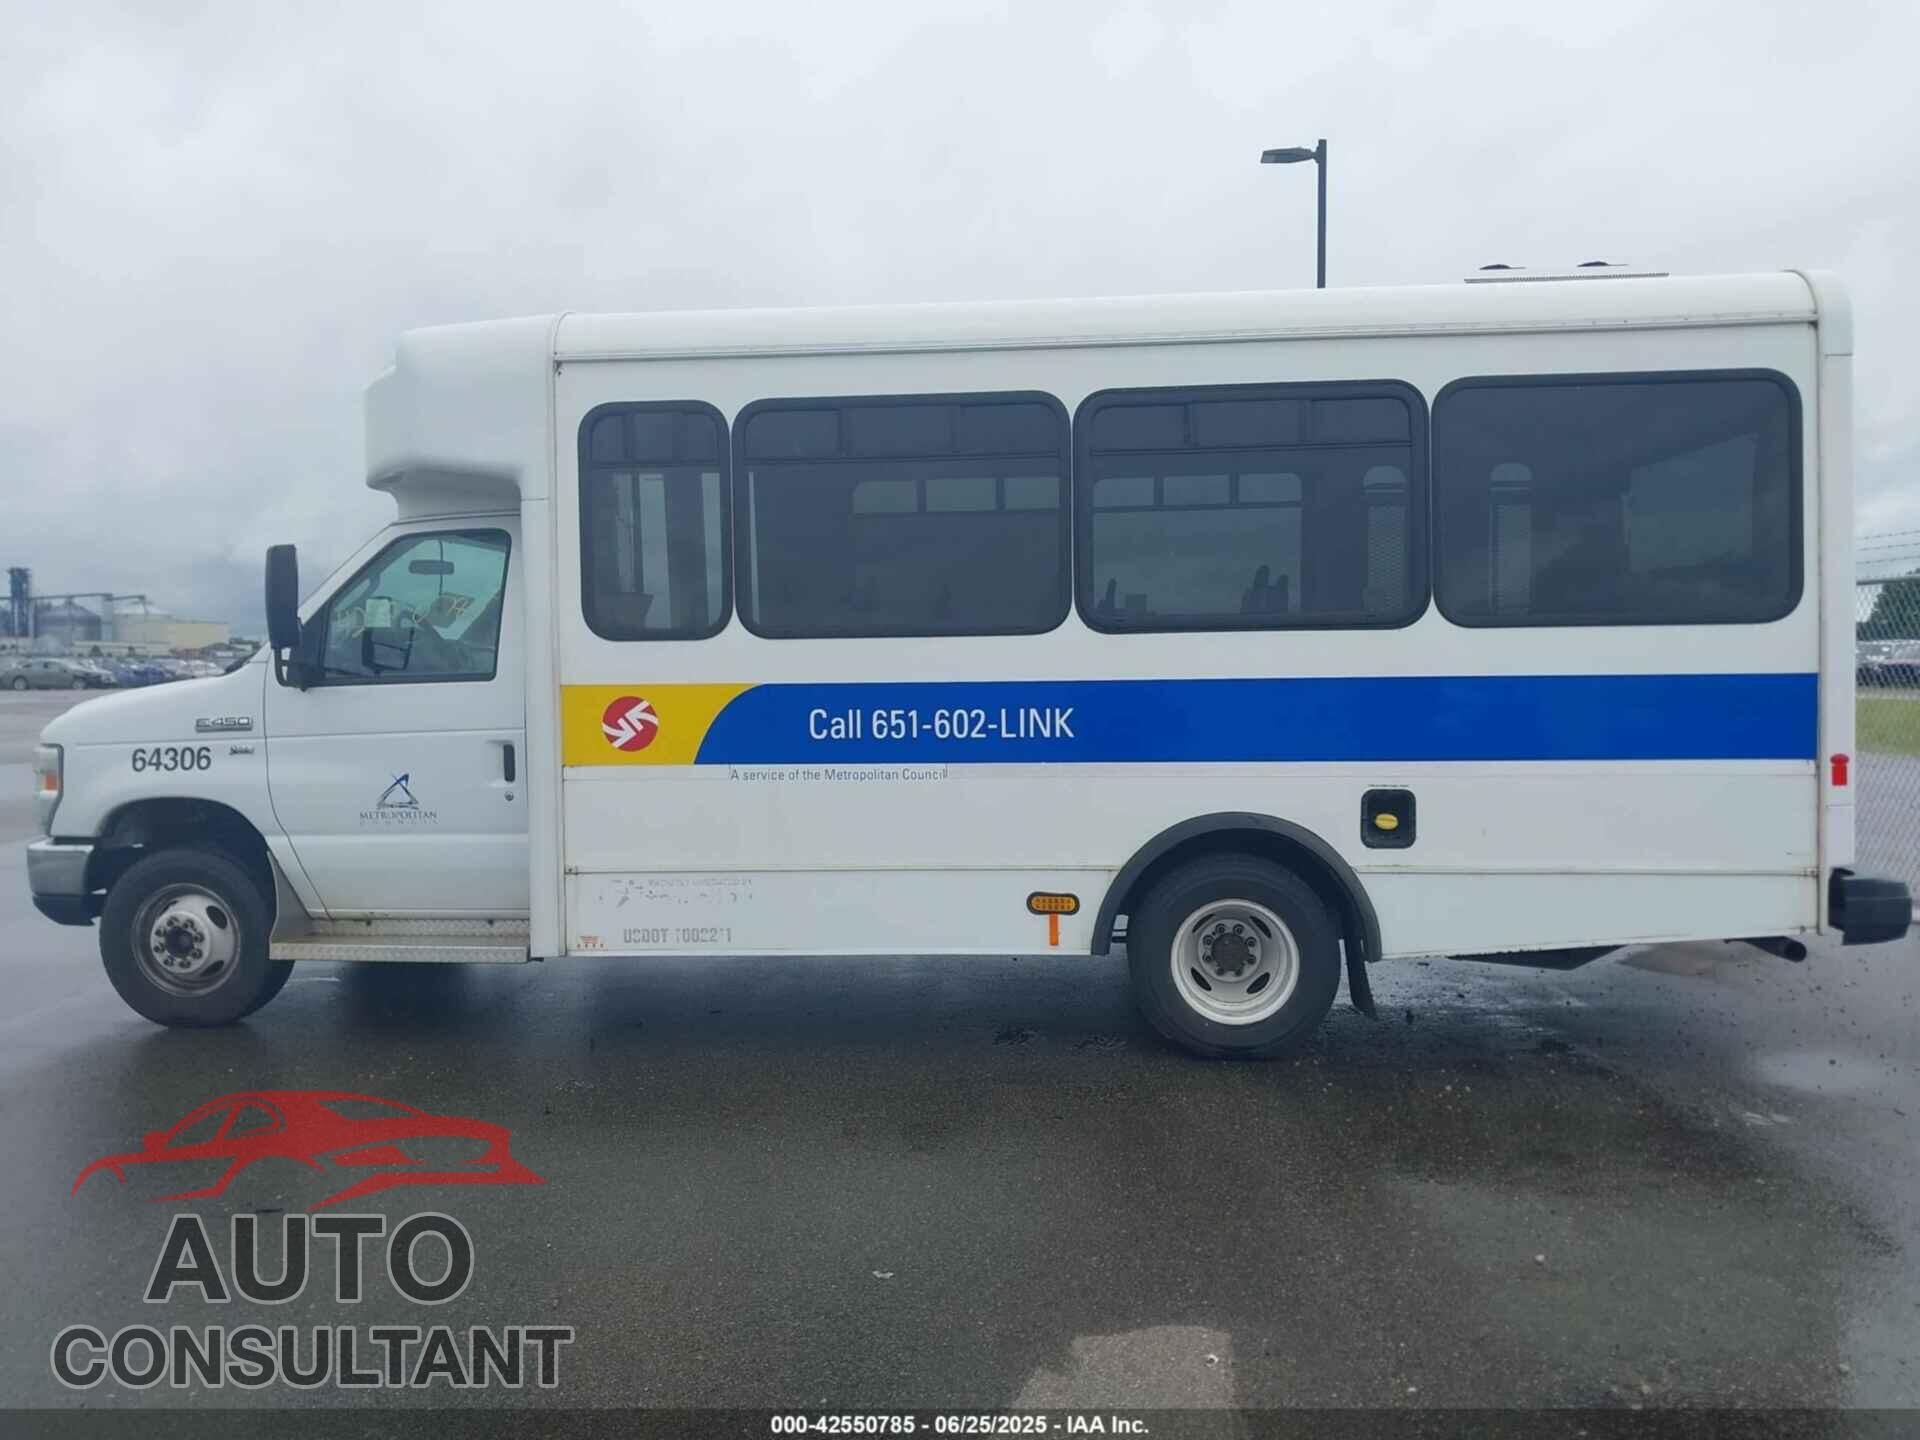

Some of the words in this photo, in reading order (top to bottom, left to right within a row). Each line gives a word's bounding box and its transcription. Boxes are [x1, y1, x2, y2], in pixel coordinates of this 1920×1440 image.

[808, 708, 862, 740] Call
[871, 707, 1075, 740] 651-602-LINK
[131, 746, 212, 772] 64306
[730, 769, 740, 781] A
[743, 769, 785, 781] service
[788, 768, 801, 781] of
[802, 768, 821, 781] the
[824, 767, 900, 784] Metropolitan
[902, 766, 947, 781] Council
